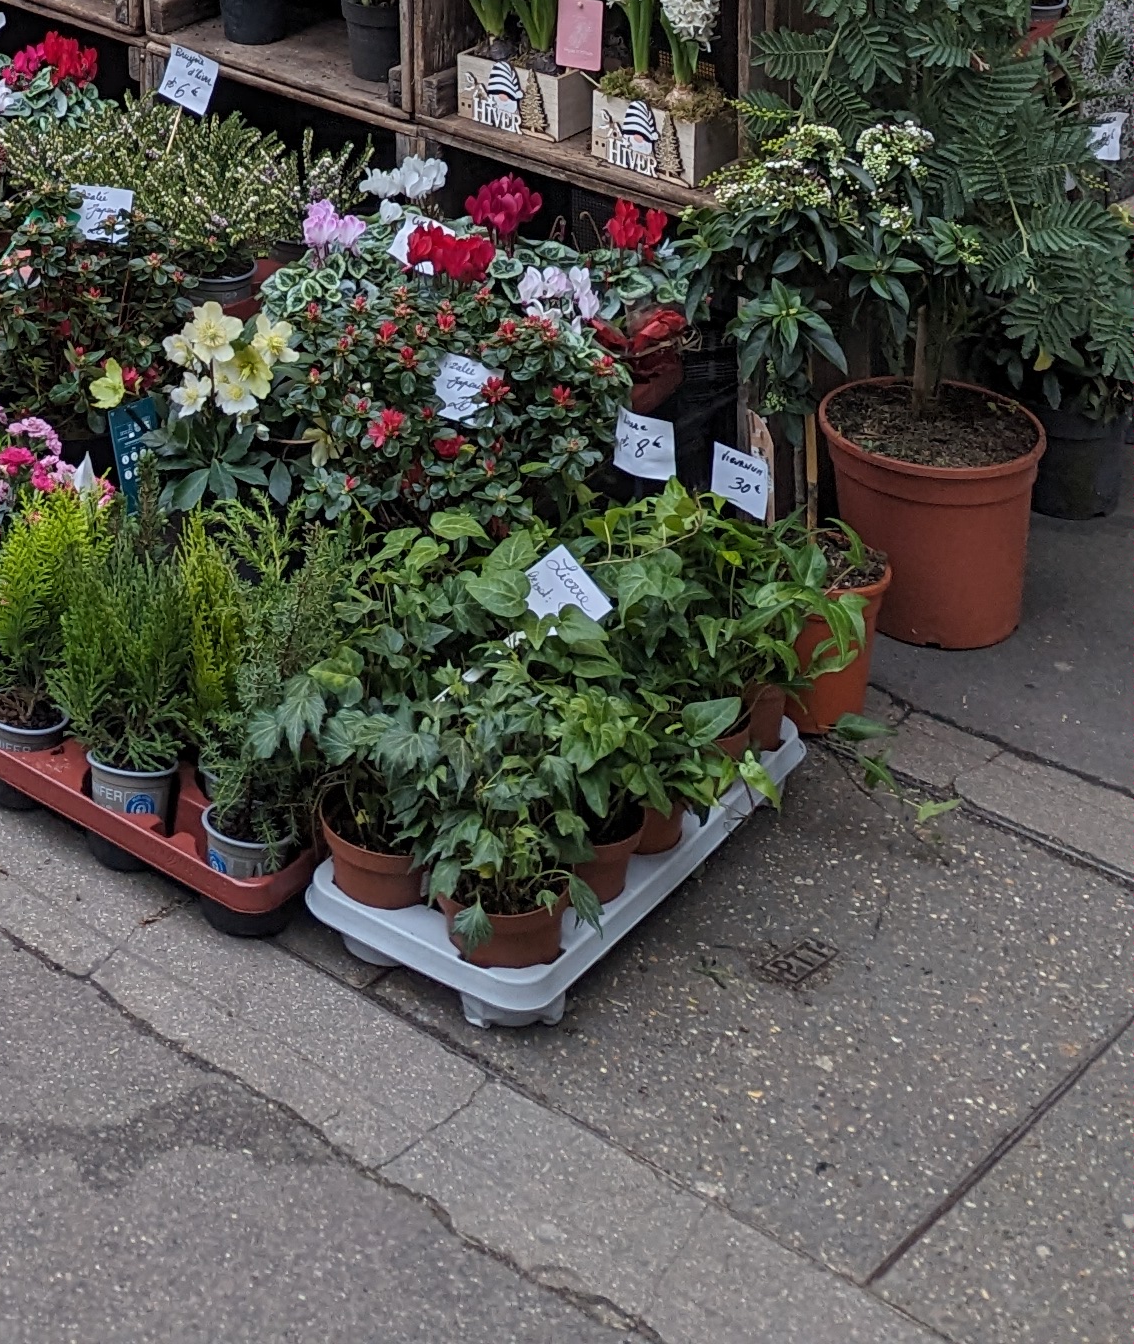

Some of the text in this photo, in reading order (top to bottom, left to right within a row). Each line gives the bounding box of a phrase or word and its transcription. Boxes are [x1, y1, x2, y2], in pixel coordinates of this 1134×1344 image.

[174, 83, 201, 99] 6€
[473, 96, 523, 136] HIVER
[606, 138, 657, 178] HIVER
[635, 435, 664, 459] 8€
[727, 477, 761, 495] 30€
[545, 557, 593, 613] Lierre
